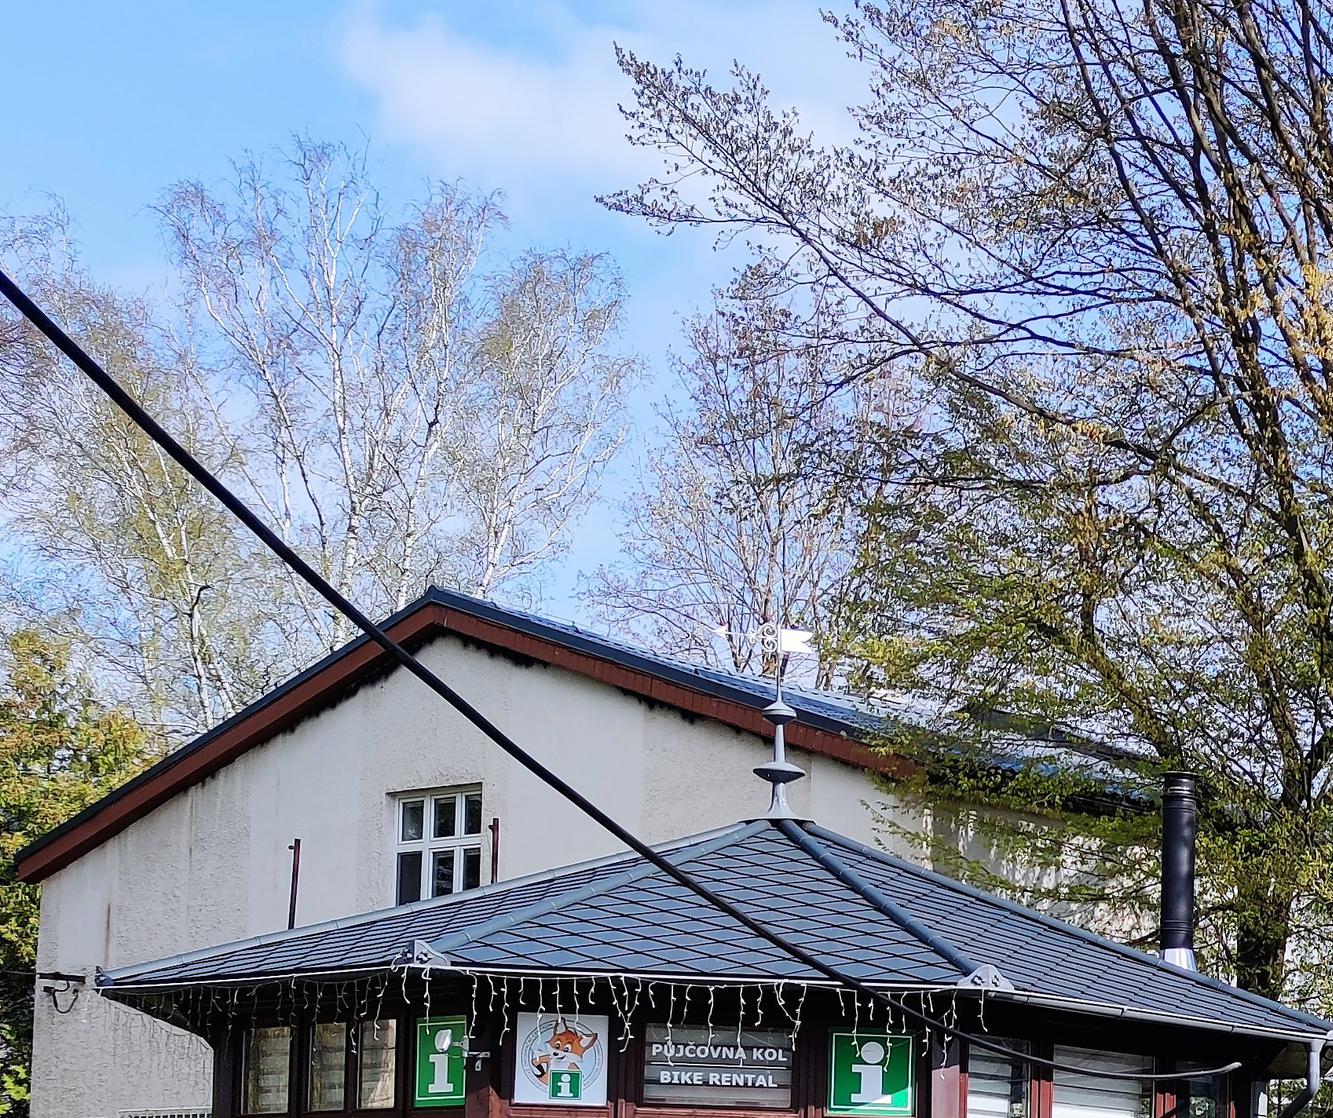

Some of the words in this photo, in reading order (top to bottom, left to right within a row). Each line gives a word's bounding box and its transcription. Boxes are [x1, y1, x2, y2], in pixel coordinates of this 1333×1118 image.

[753, 1048, 788, 1062] KOL
[659, 1070, 703, 1085] BIKE
[709, 1071, 779, 1088] RENTAL
